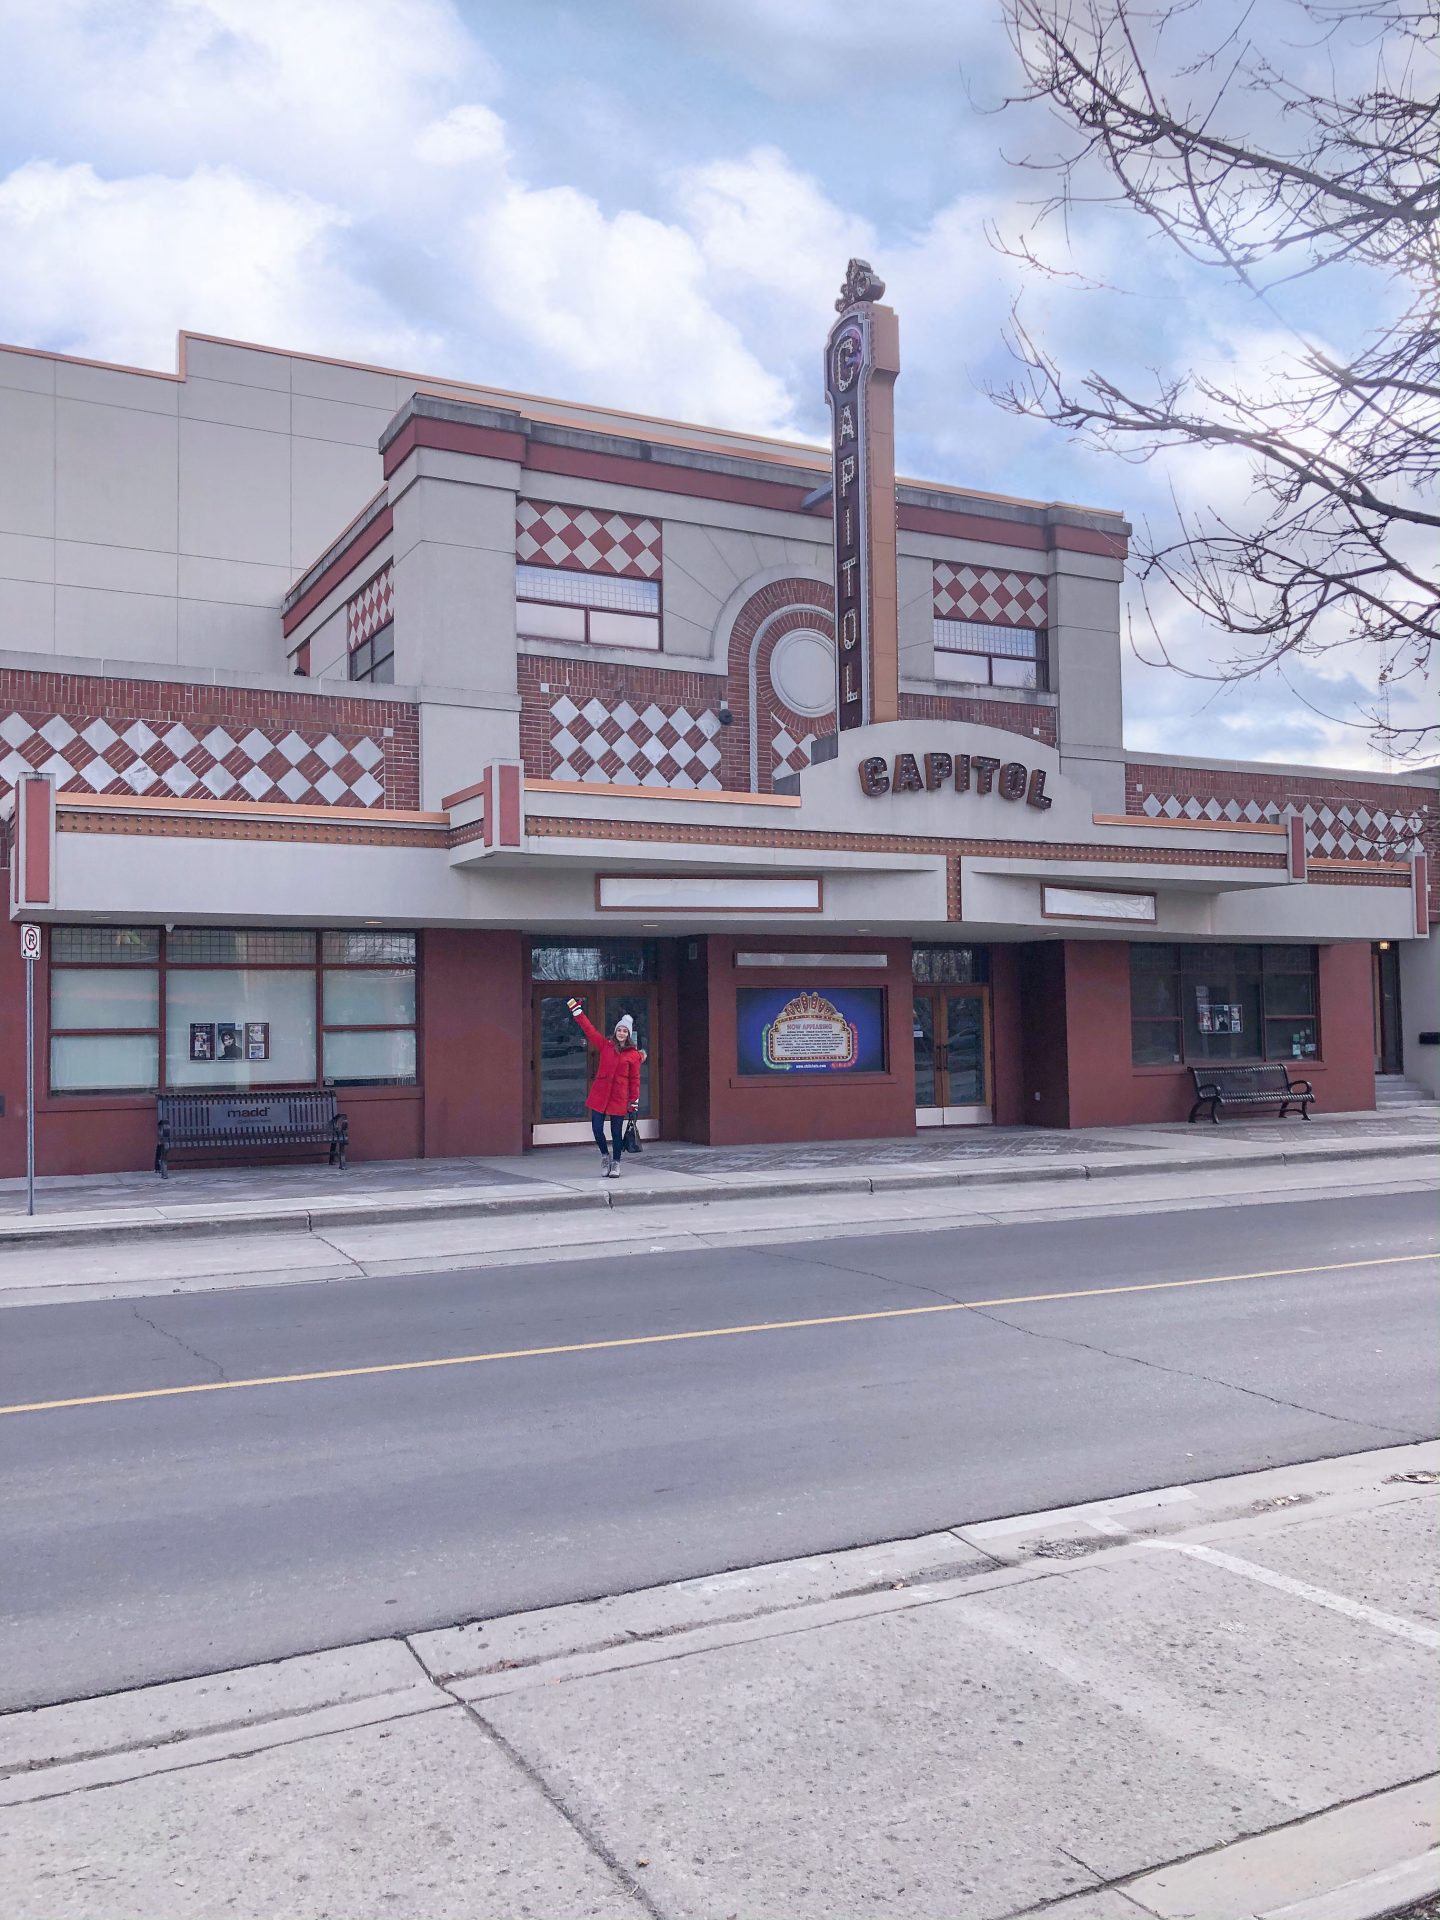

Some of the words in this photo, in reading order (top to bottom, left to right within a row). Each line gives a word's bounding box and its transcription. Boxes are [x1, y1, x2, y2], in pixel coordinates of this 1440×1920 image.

[837, 337, 858, 704] CAPITOL
[858, 752, 1053, 810] CAPITOL
[228, 1106, 268, 1118] madd
